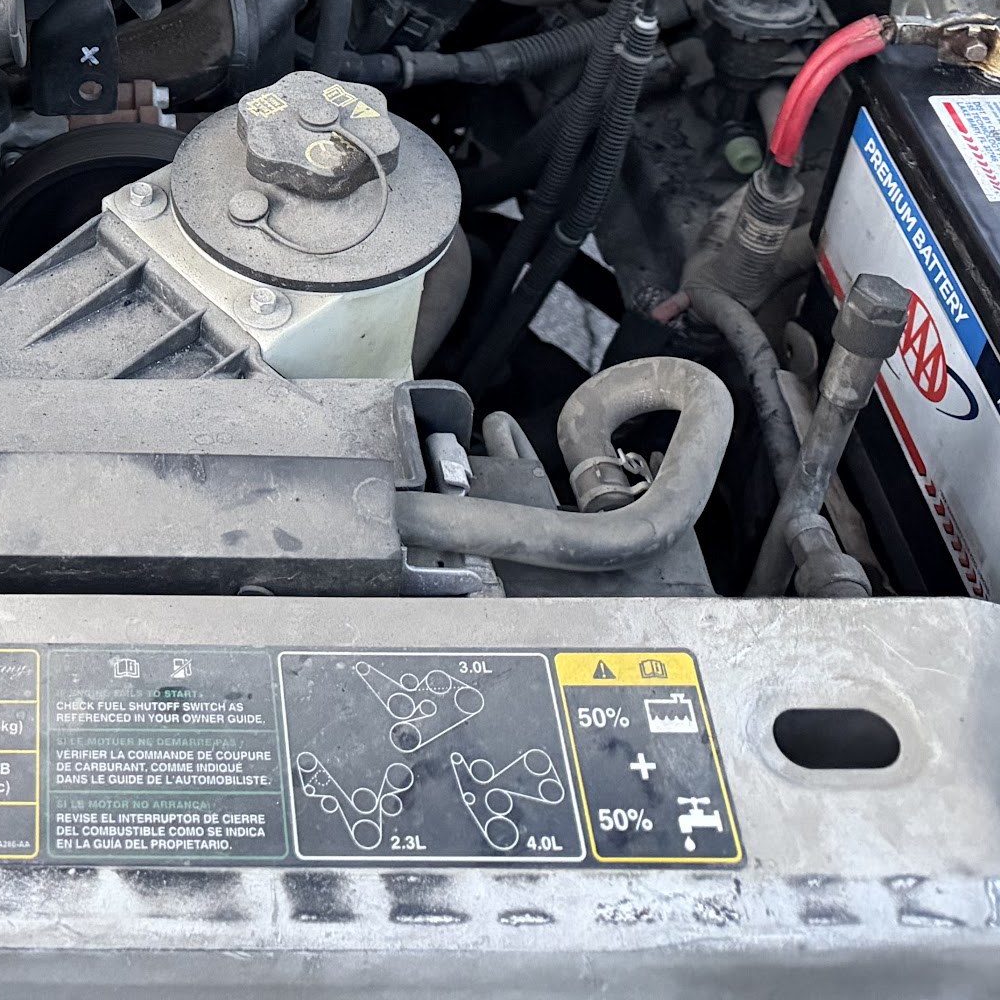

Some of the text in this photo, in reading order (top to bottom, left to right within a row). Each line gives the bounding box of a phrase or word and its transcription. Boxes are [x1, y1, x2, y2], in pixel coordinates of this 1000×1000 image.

[863, 137, 970, 324] PREMIUM BATTERY
[458, 661, 493, 675] 3.0L
[56, 701, 244, 712] CHECK FUEL SHUTOFF SWITCH AS
[56, 713, 266, 724] REFERENCED IN YOUR OWNER GUIDE.
[578, 706, 630, 728] 50%
[1, 719, 23, 735] kg)
[110, 749, 125, 760] LA
[128, 750, 194, 760] COMMANDE
[197, 750, 213, 760] DE
[215, 750, 272, 761] COUPURE
[56, 762, 71, 772] DE
[150, 762, 193, 773] COMME
[196, 761, 243, 773] INDIQUÉ
[56, 774, 272, 786] DANS LE GUIDE DE L'AUTOMOBILISTE.
[88, 800, 129, 809] MOTOR
[133, 800, 149, 809] NO
[56, 813, 98, 823] REVISE
[101, 813, 116, 823] EL
[118, 813, 201, 824] INTERRUPTOR
[222, 814, 266, 824] CIERRE
[598, 807, 653, 831] 50%
[56, 826, 266, 837] DEL COMBUSTIBLE COMO SE INDICA
[56, 836, 233, 850] EN LA GUÍA DEL PROPIETARIO.
[390, 836, 427, 850] 2.3L
[526, 836, 563, 851] 4.0L
